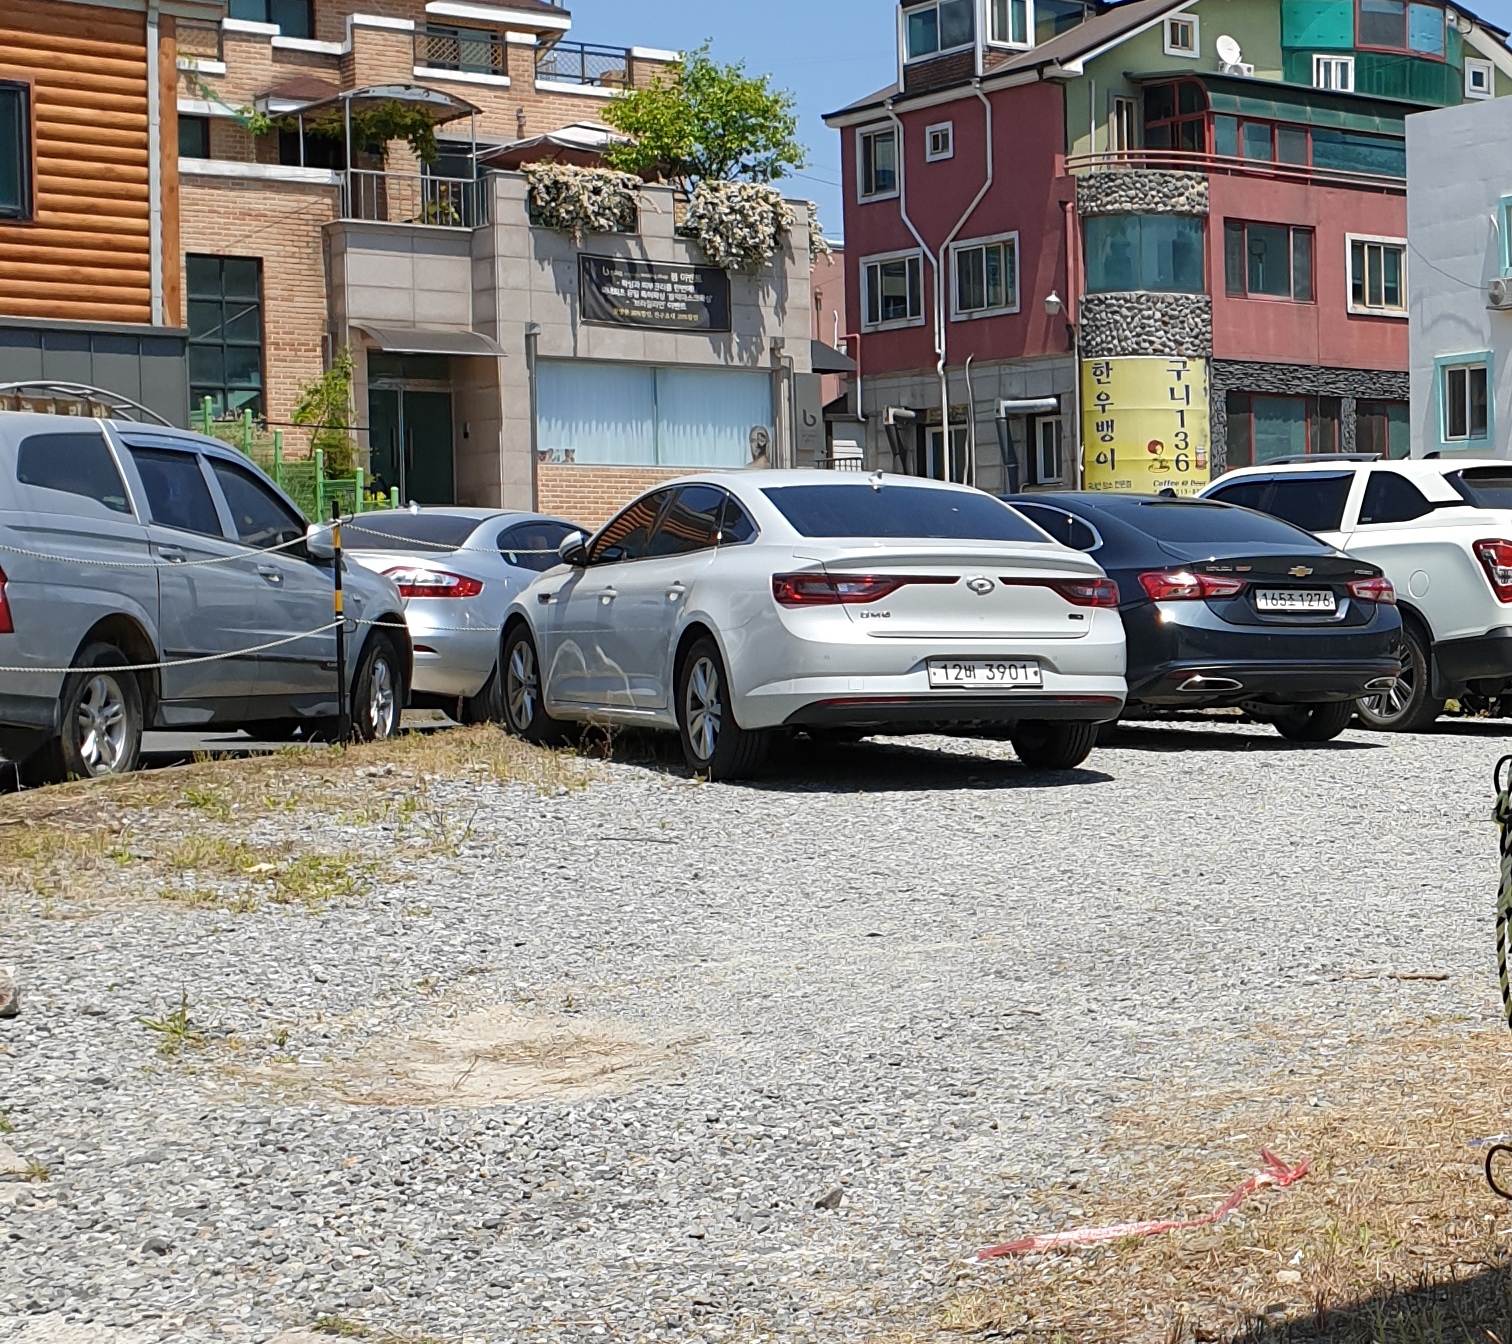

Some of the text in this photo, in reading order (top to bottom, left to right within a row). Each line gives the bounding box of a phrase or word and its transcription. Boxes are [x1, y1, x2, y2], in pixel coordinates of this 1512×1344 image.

[1092, 361, 1115, 471] 한우뱅이
[1299, 592, 1331, 607] 1276
[941, 663, 1028, 681] 12버 3901
